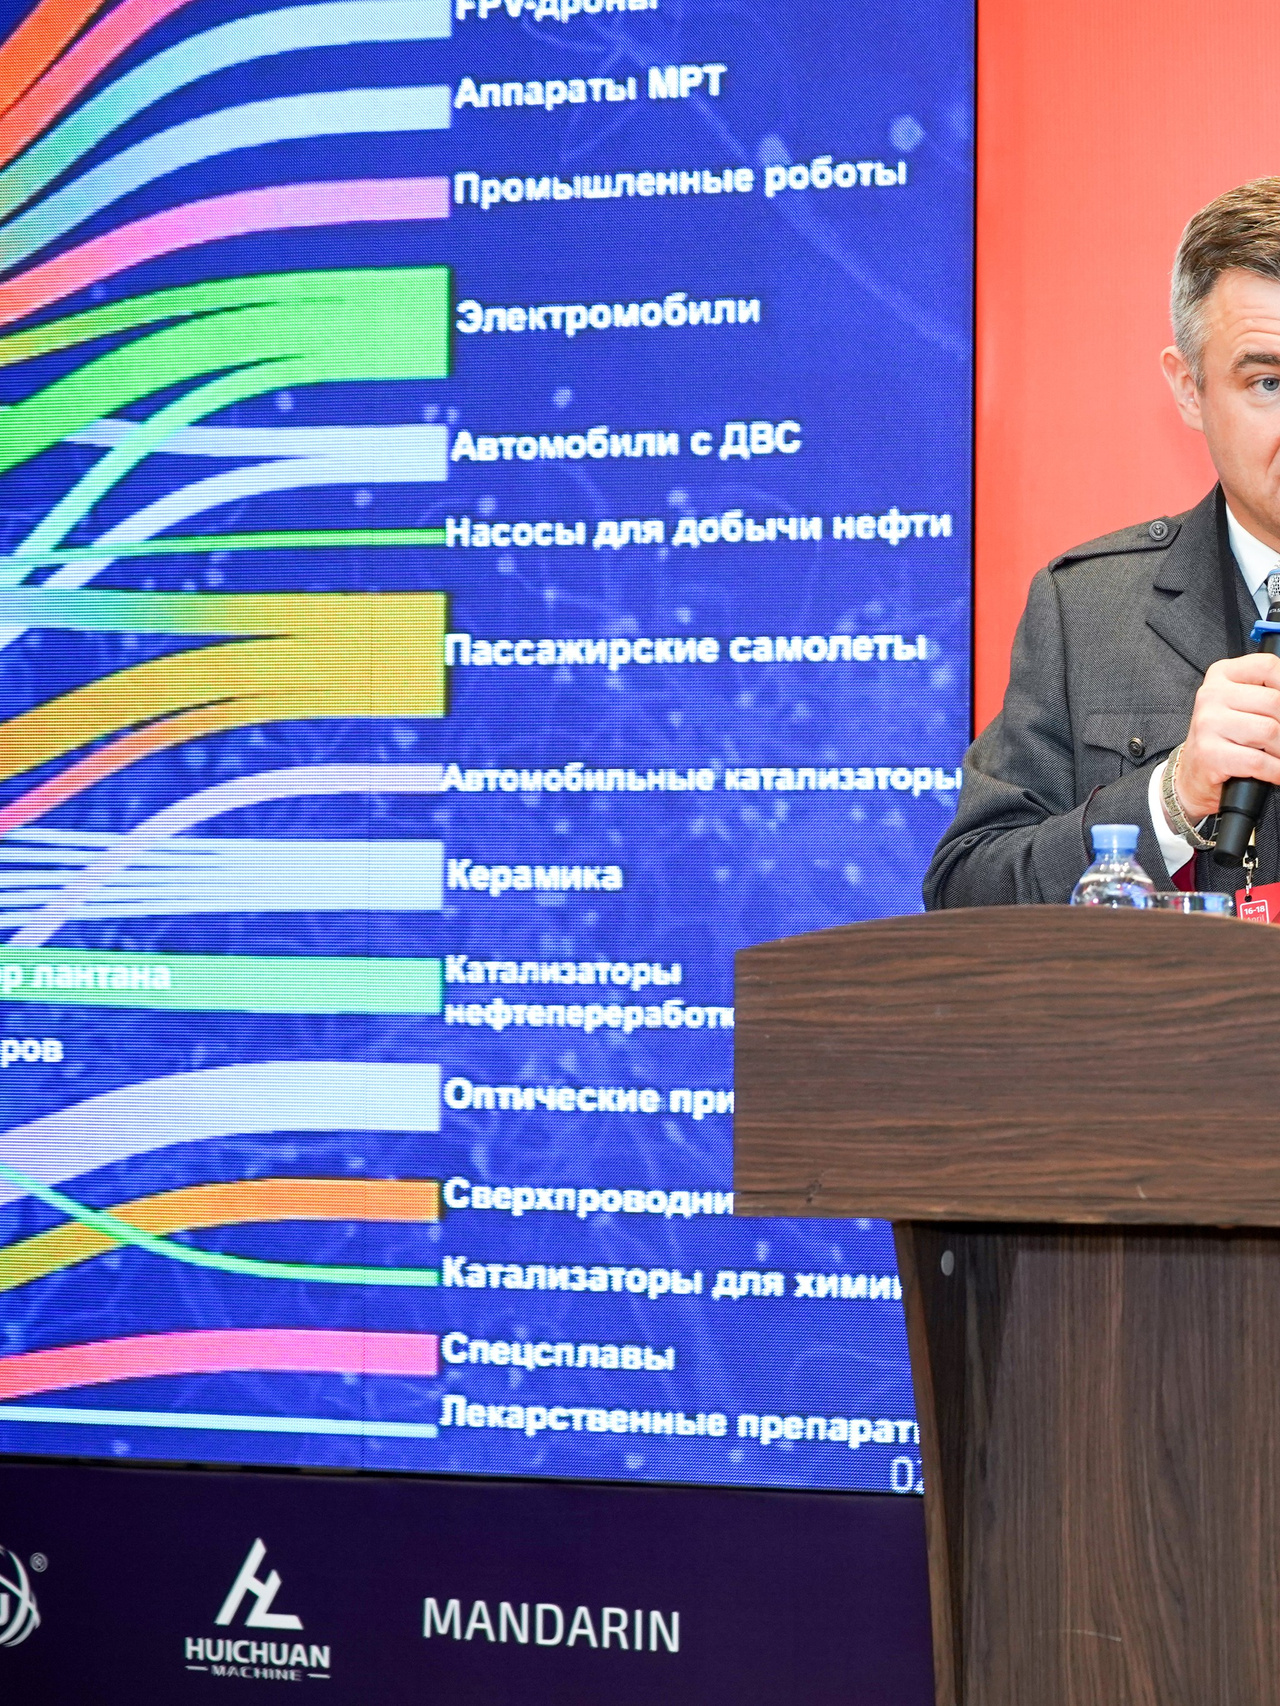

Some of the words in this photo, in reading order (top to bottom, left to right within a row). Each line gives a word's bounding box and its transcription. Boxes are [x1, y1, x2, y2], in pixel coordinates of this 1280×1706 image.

[454, 78, 635, 110] Аппараты
[648, 65, 726, 98] МРТ
[456, 169, 753, 209] Промышленные
[766, 157, 905, 197] роботы
[458, 293, 759, 336] Электромобили
[452, 427, 678, 460] Автомобили
[692, 433, 711, 455] с
[720, 422, 800, 459] ДВС
[447, 518, 585, 546] Насосы
[594, 521, 663, 549] для
[673, 511, 821, 546] добычи
[834, 509, 951, 544] нефти
[445, 634, 718, 669] Пассажирские
[730, 636, 927, 662] самолеты
[442, 763, 715, 791] Автомобильные
[726, 768, 961, 796] катализаторы
[449, 860, 622, 896] Керамика
[1243, 905, 1266, 915] 16-18
[31, 965, 172, 989] лантана
[447, 956, 680, 990] Катализаторы
[445, 1078, 660, 1112] Оптические
[670, 1090, 734, 1120] при
[445, 1178, 733, 1217] Сверхпроводни
[444, 1257, 701, 1299] Катализаторы
[713, 1272, 783, 1298] для
[443, 1333, 673, 1369] Спецсплавы
[441, 1395, 726, 1436] Лекарственные
[423, 1597, 679, 1652] MANDARIN
[185, 1637, 331, 1668] HUICHUAN
[211, 1665, 302, 1682] MACHINE
